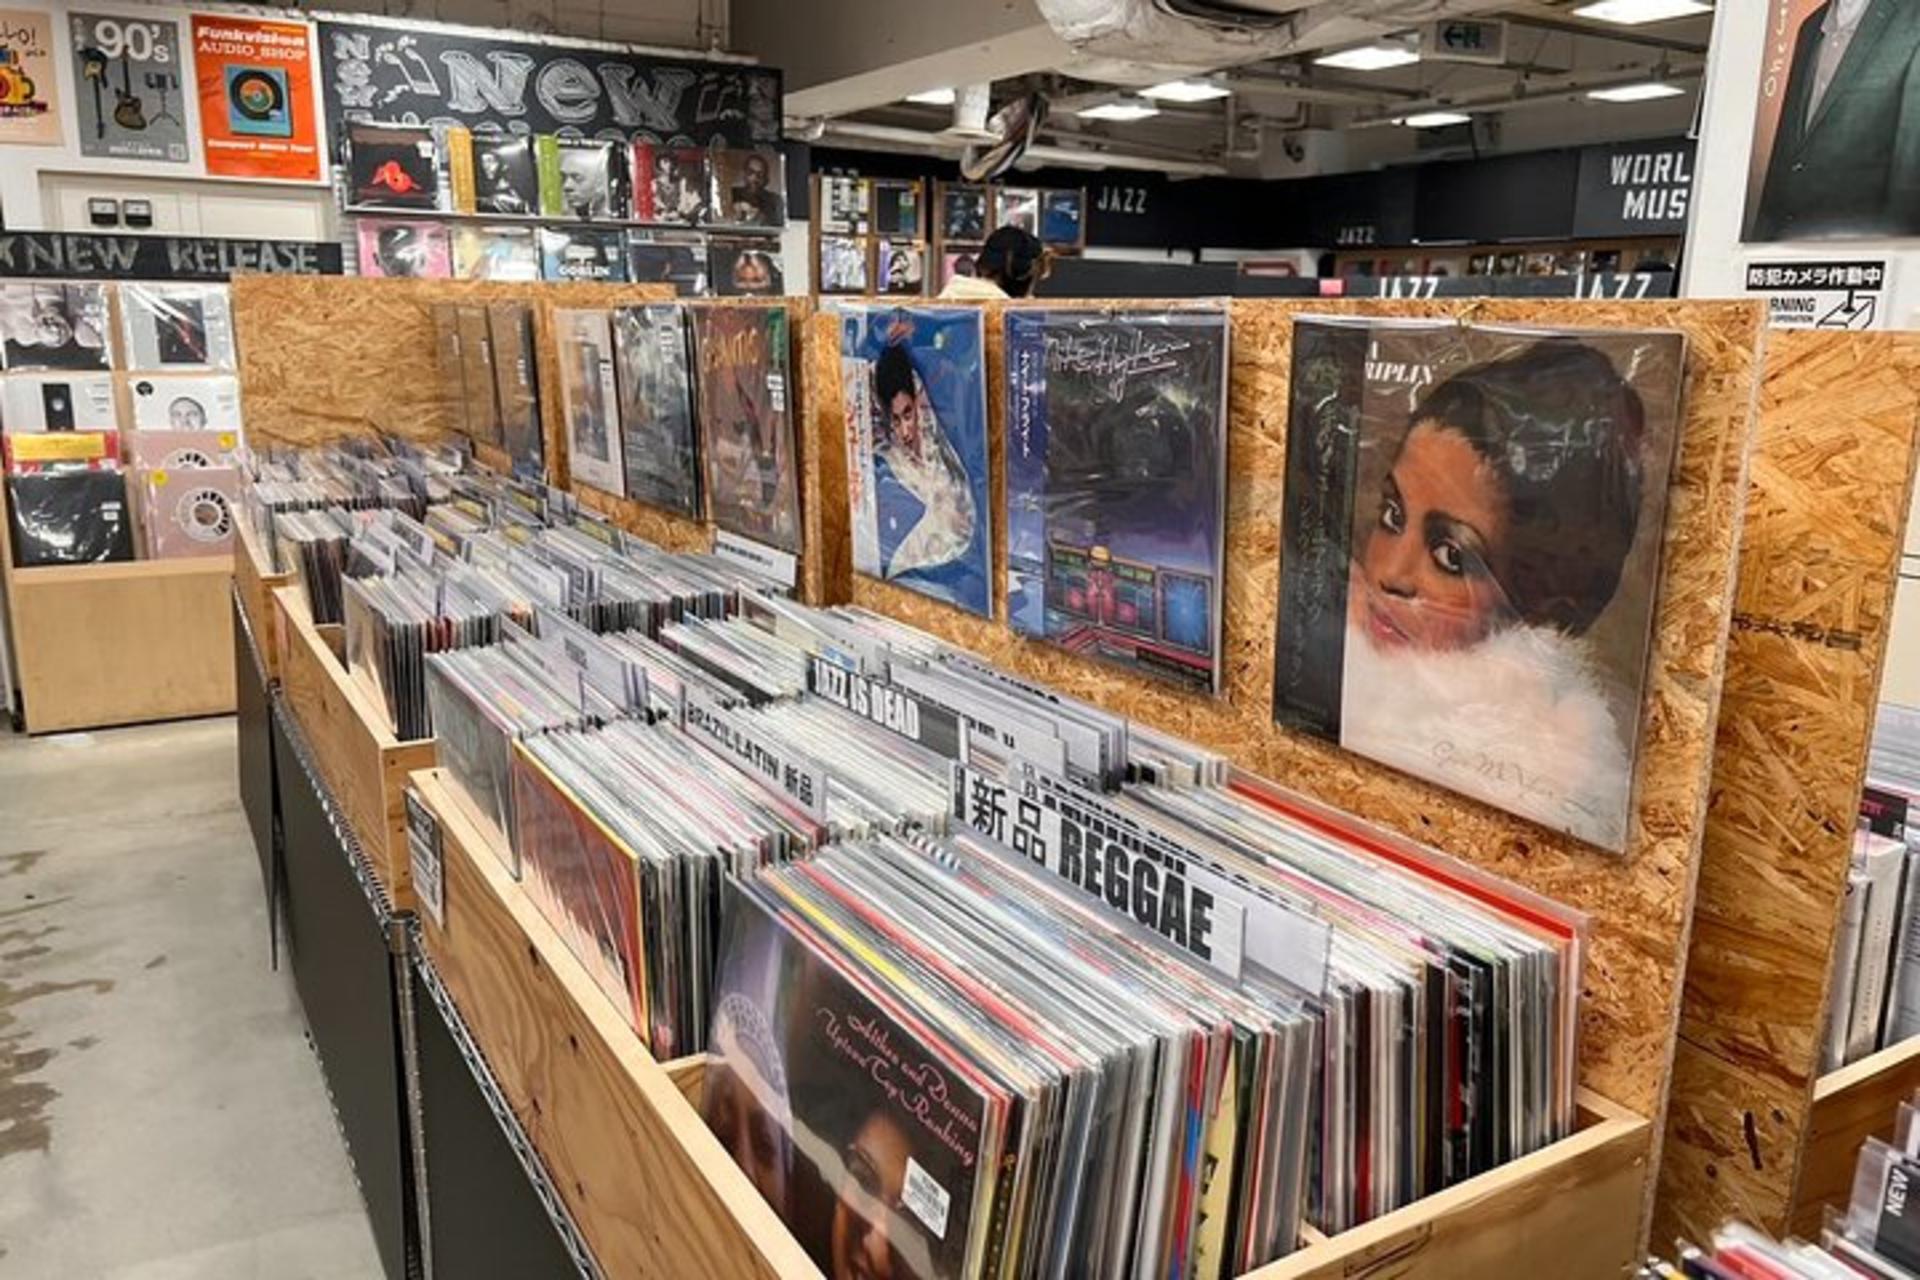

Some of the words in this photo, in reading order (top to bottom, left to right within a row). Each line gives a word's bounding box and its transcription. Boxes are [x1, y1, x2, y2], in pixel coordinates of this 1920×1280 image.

[95, 20, 170, 63] 90's
[439, 50, 697, 131] New
[1097, 187, 1147, 215] JAZZ
[1622, 188, 1687, 219] MUS
[1337, 226, 1376, 245] JAZZ
[26, 236, 138, 272] NEW
[165, 239, 320, 274] RELEASE
[1378, 276, 1440, 299] JAZZ
[1575, 274, 1652, 299] JAZZ
[1748, 266, 1881, 286] 防犯カメラ作動中
[815, 657, 849, 707] JAZZ
[850, 674, 869, 716] IS
[871, 682, 920, 740] DEAD
[972, 777, 1048, 868] 新品
[1058, 817, 1215, 961] REGGAE
[1885, 1167, 1909, 1217] NEW
